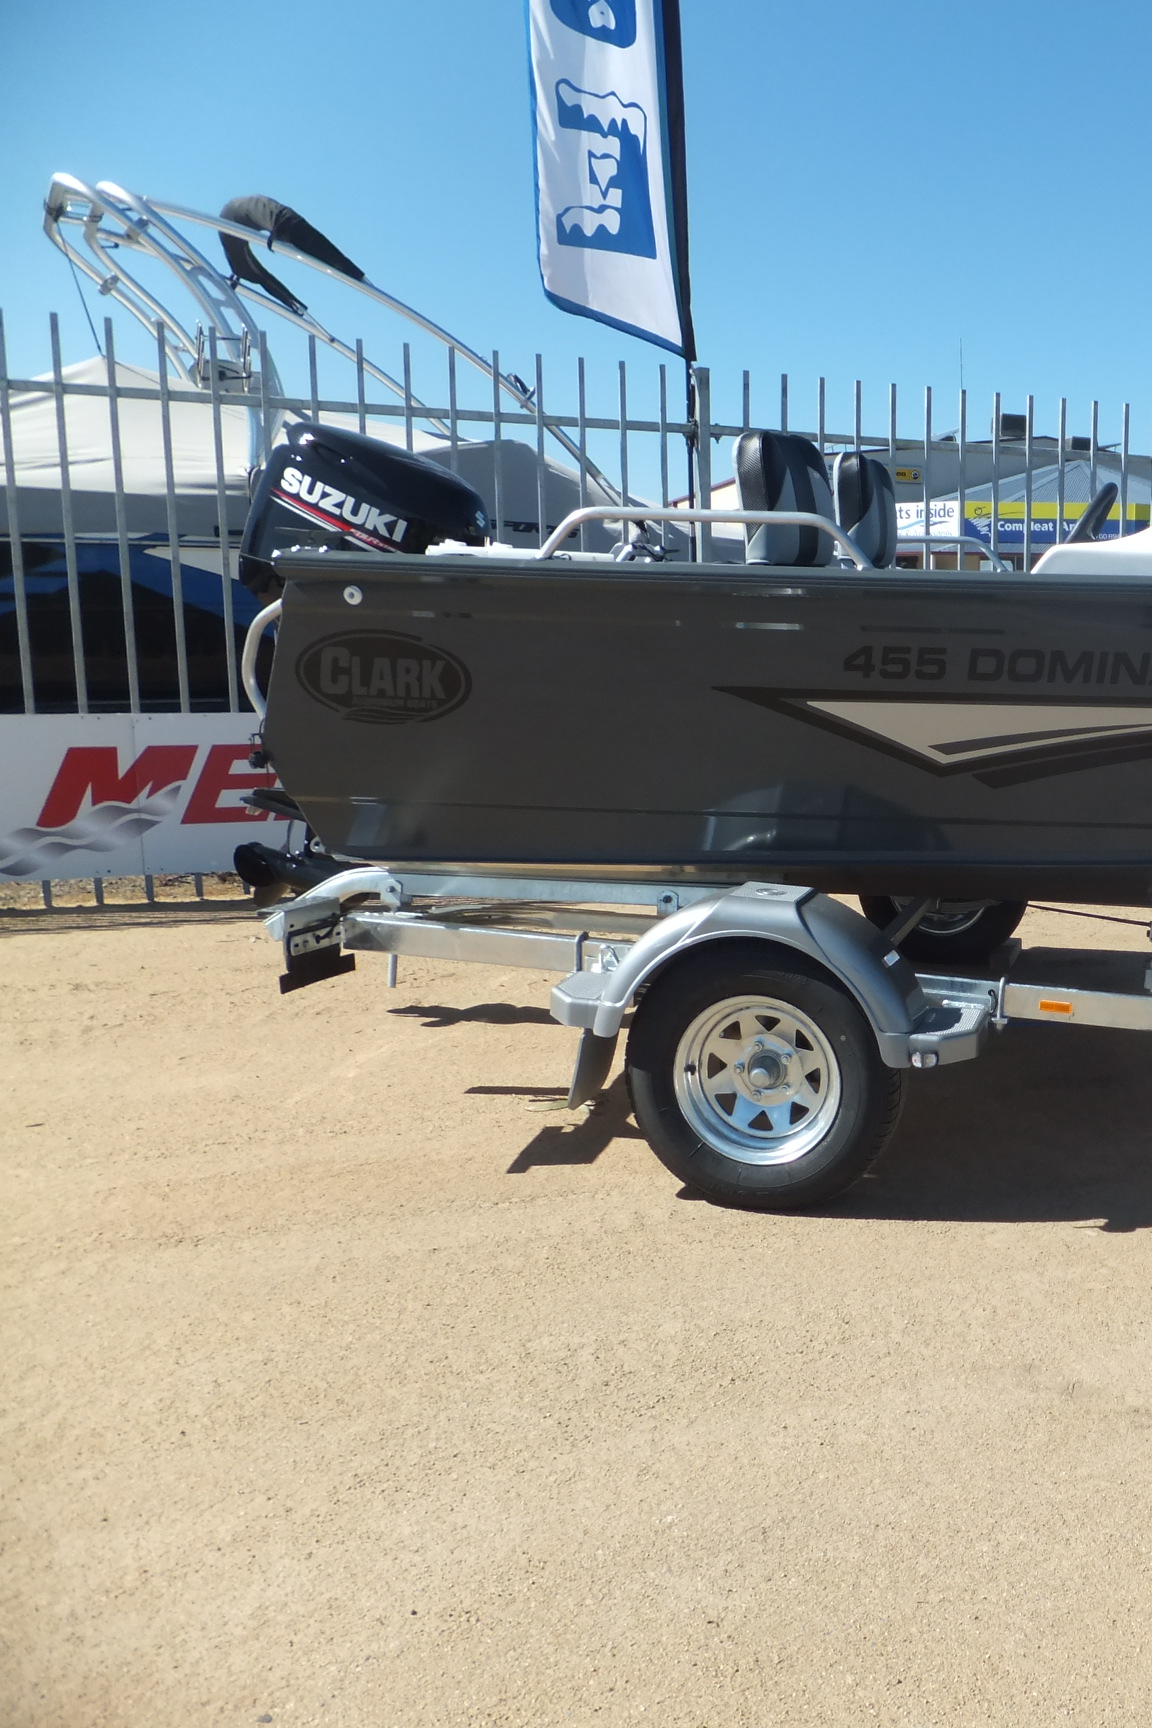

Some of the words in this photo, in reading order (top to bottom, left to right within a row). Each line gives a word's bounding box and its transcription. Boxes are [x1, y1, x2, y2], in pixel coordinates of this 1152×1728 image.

[280, 467, 408, 543] SUZUKI
[319, 646, 447, 699] CLARK
[843, 645, 948, 681] 455
[36, 744, 293, 828] ME
